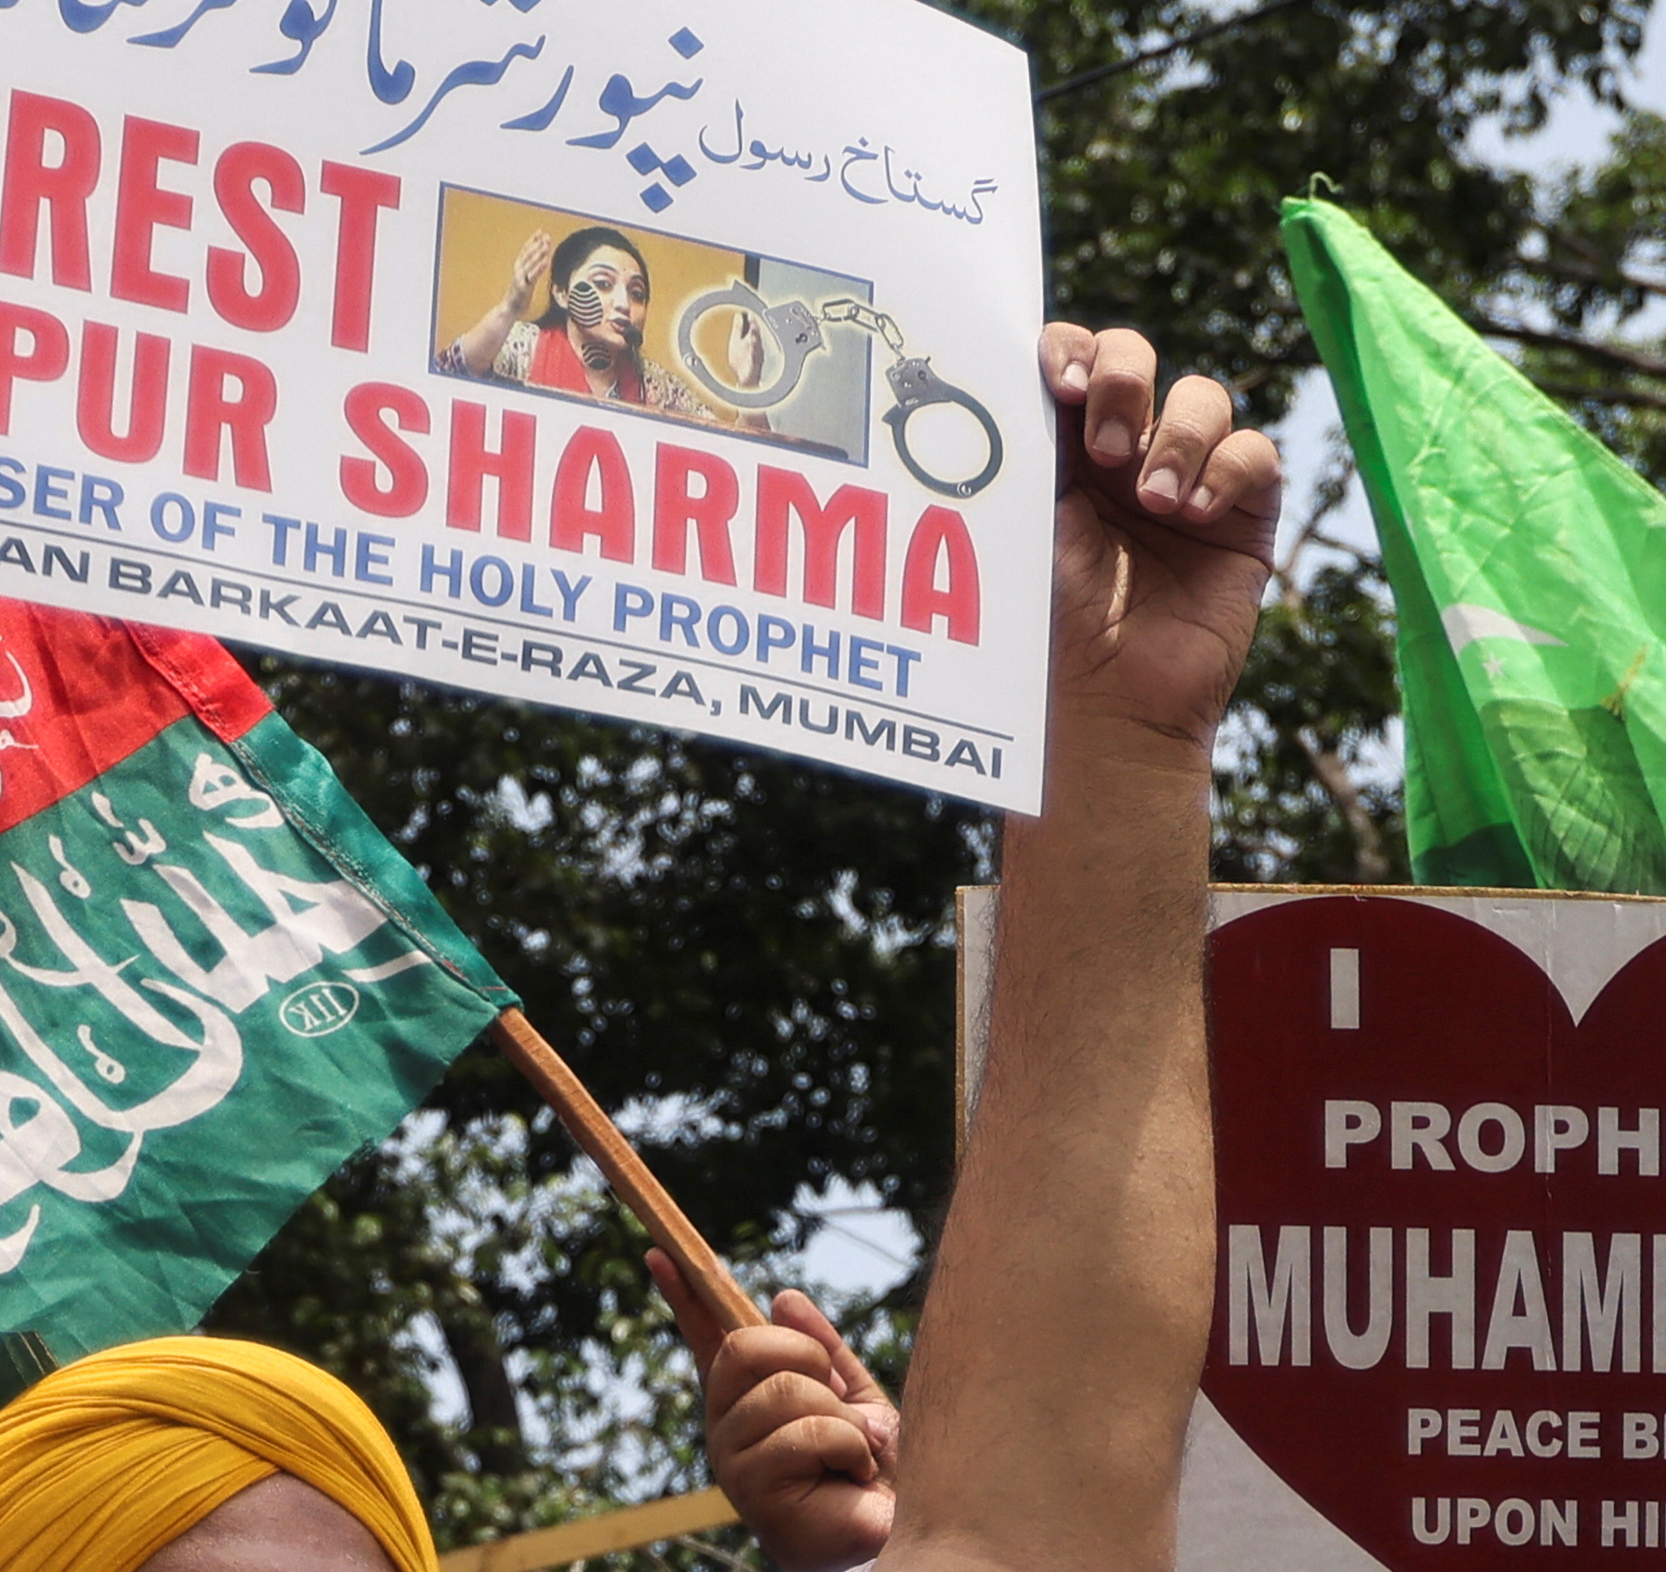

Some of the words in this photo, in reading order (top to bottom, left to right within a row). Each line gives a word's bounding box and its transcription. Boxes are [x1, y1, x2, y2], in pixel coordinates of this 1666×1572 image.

[699, 99, 832, 181] رسول
[839, 137, 999, 225] گستاخ
[340, 381, 981, 647] SHARMA
[149, 491, 243, 552] OF
[262, 513, 395, 586] THE
[419, 543, 592, 622] HOLY
[613, 581, 922, 697] PROPHET
[108, 557, 722, 716] BARKAAT-E-RAZA,
[739, 684, 1004, 779] MUMBAI
[1329, 947, 1361, 1030] I
[1406, 1408, 1603, 1460] PEACE
[1411, 1495, 1579, 1550] UPON
